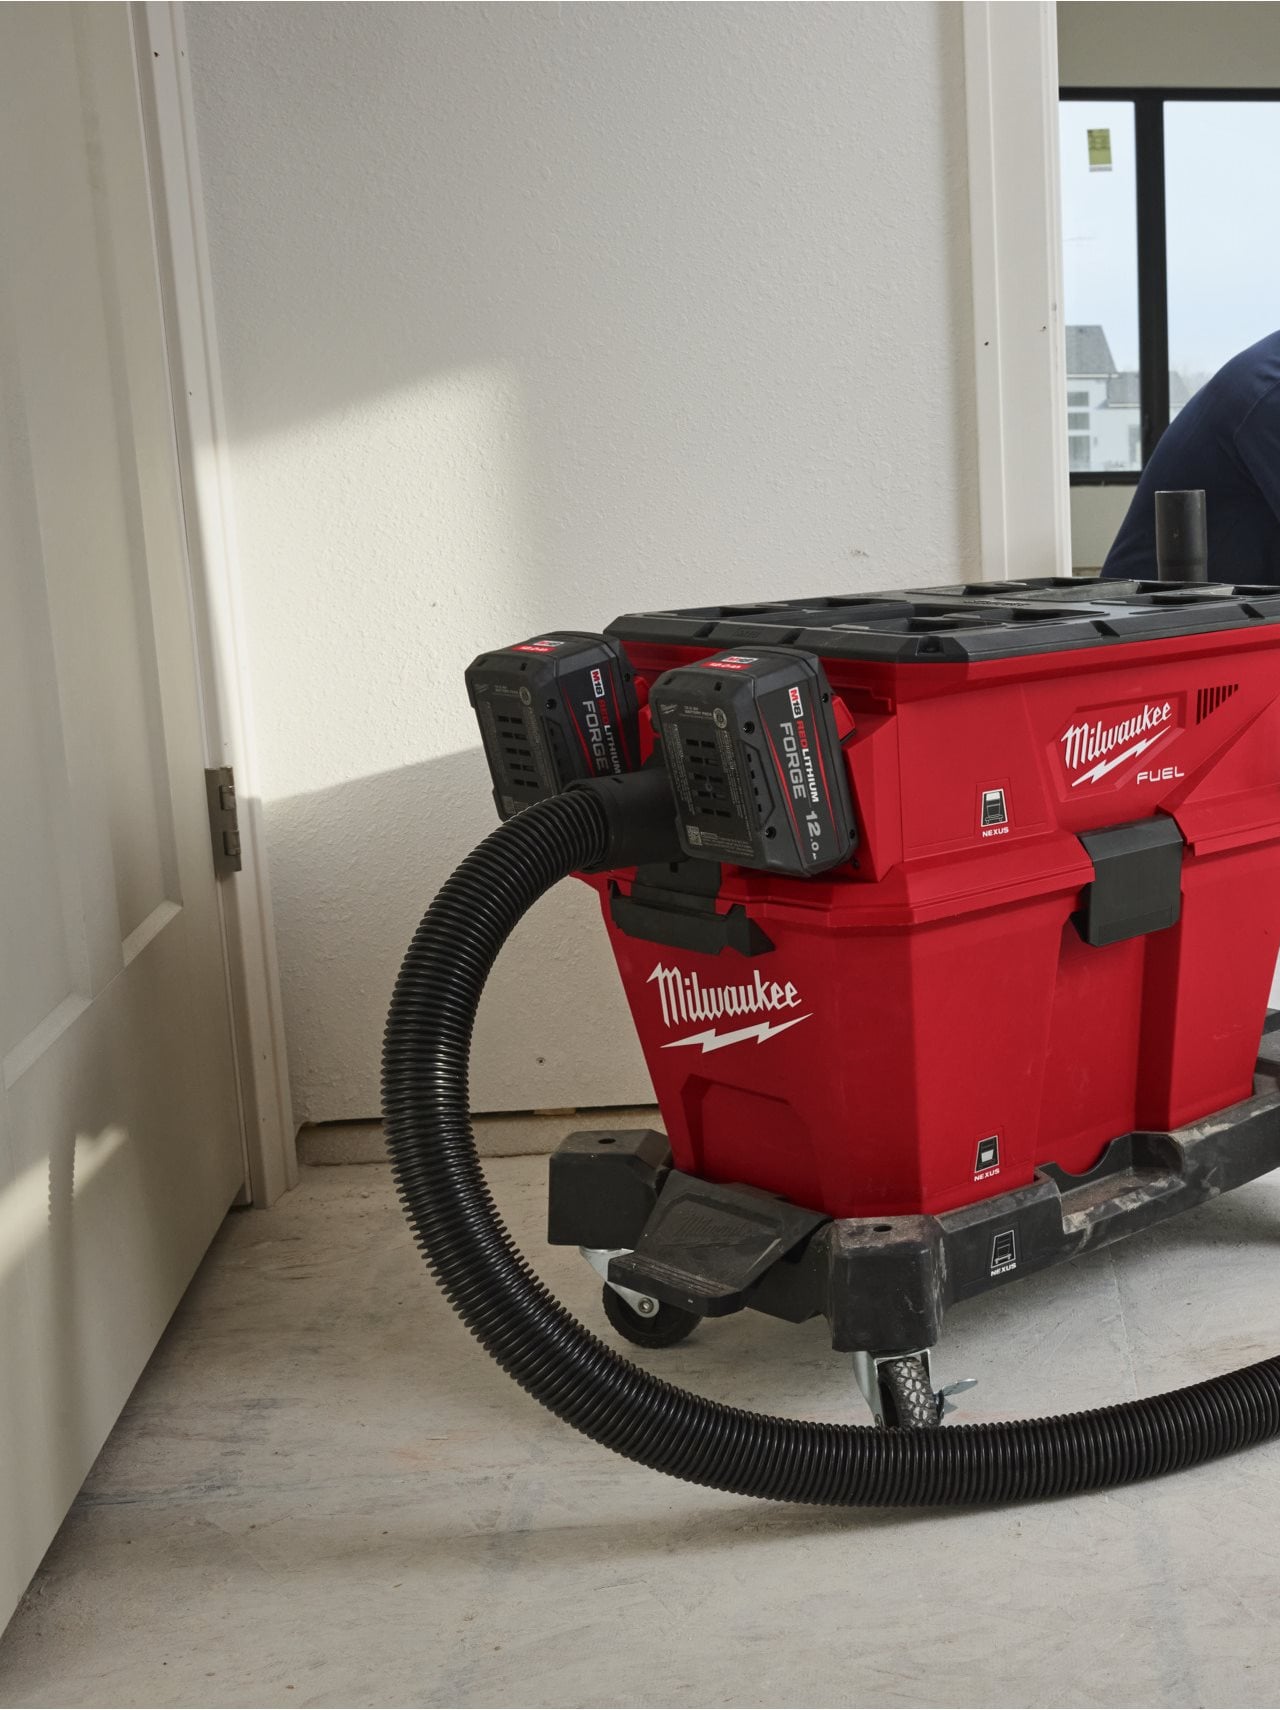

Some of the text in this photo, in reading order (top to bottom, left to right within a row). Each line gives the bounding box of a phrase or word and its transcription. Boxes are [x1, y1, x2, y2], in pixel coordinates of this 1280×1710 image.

[591, 669, 604, 696] M18
[582, 701, 609, 770] FORGE
[789, 688, 819, 803] M18 REDLITHIUM
[1060, 702, 1172, 770] Milwaukee
[780, 722, 806, 799] FORGE
[1136, 766, 1185, 785] FUEL
[982, 826, 1009, 837] NEXUS
[646, 962, 802, 1028] Milwaukee
[974, 1168, 1000, 1181] NEXUS
[990, 1262, 1017, 1277] NEXUS
